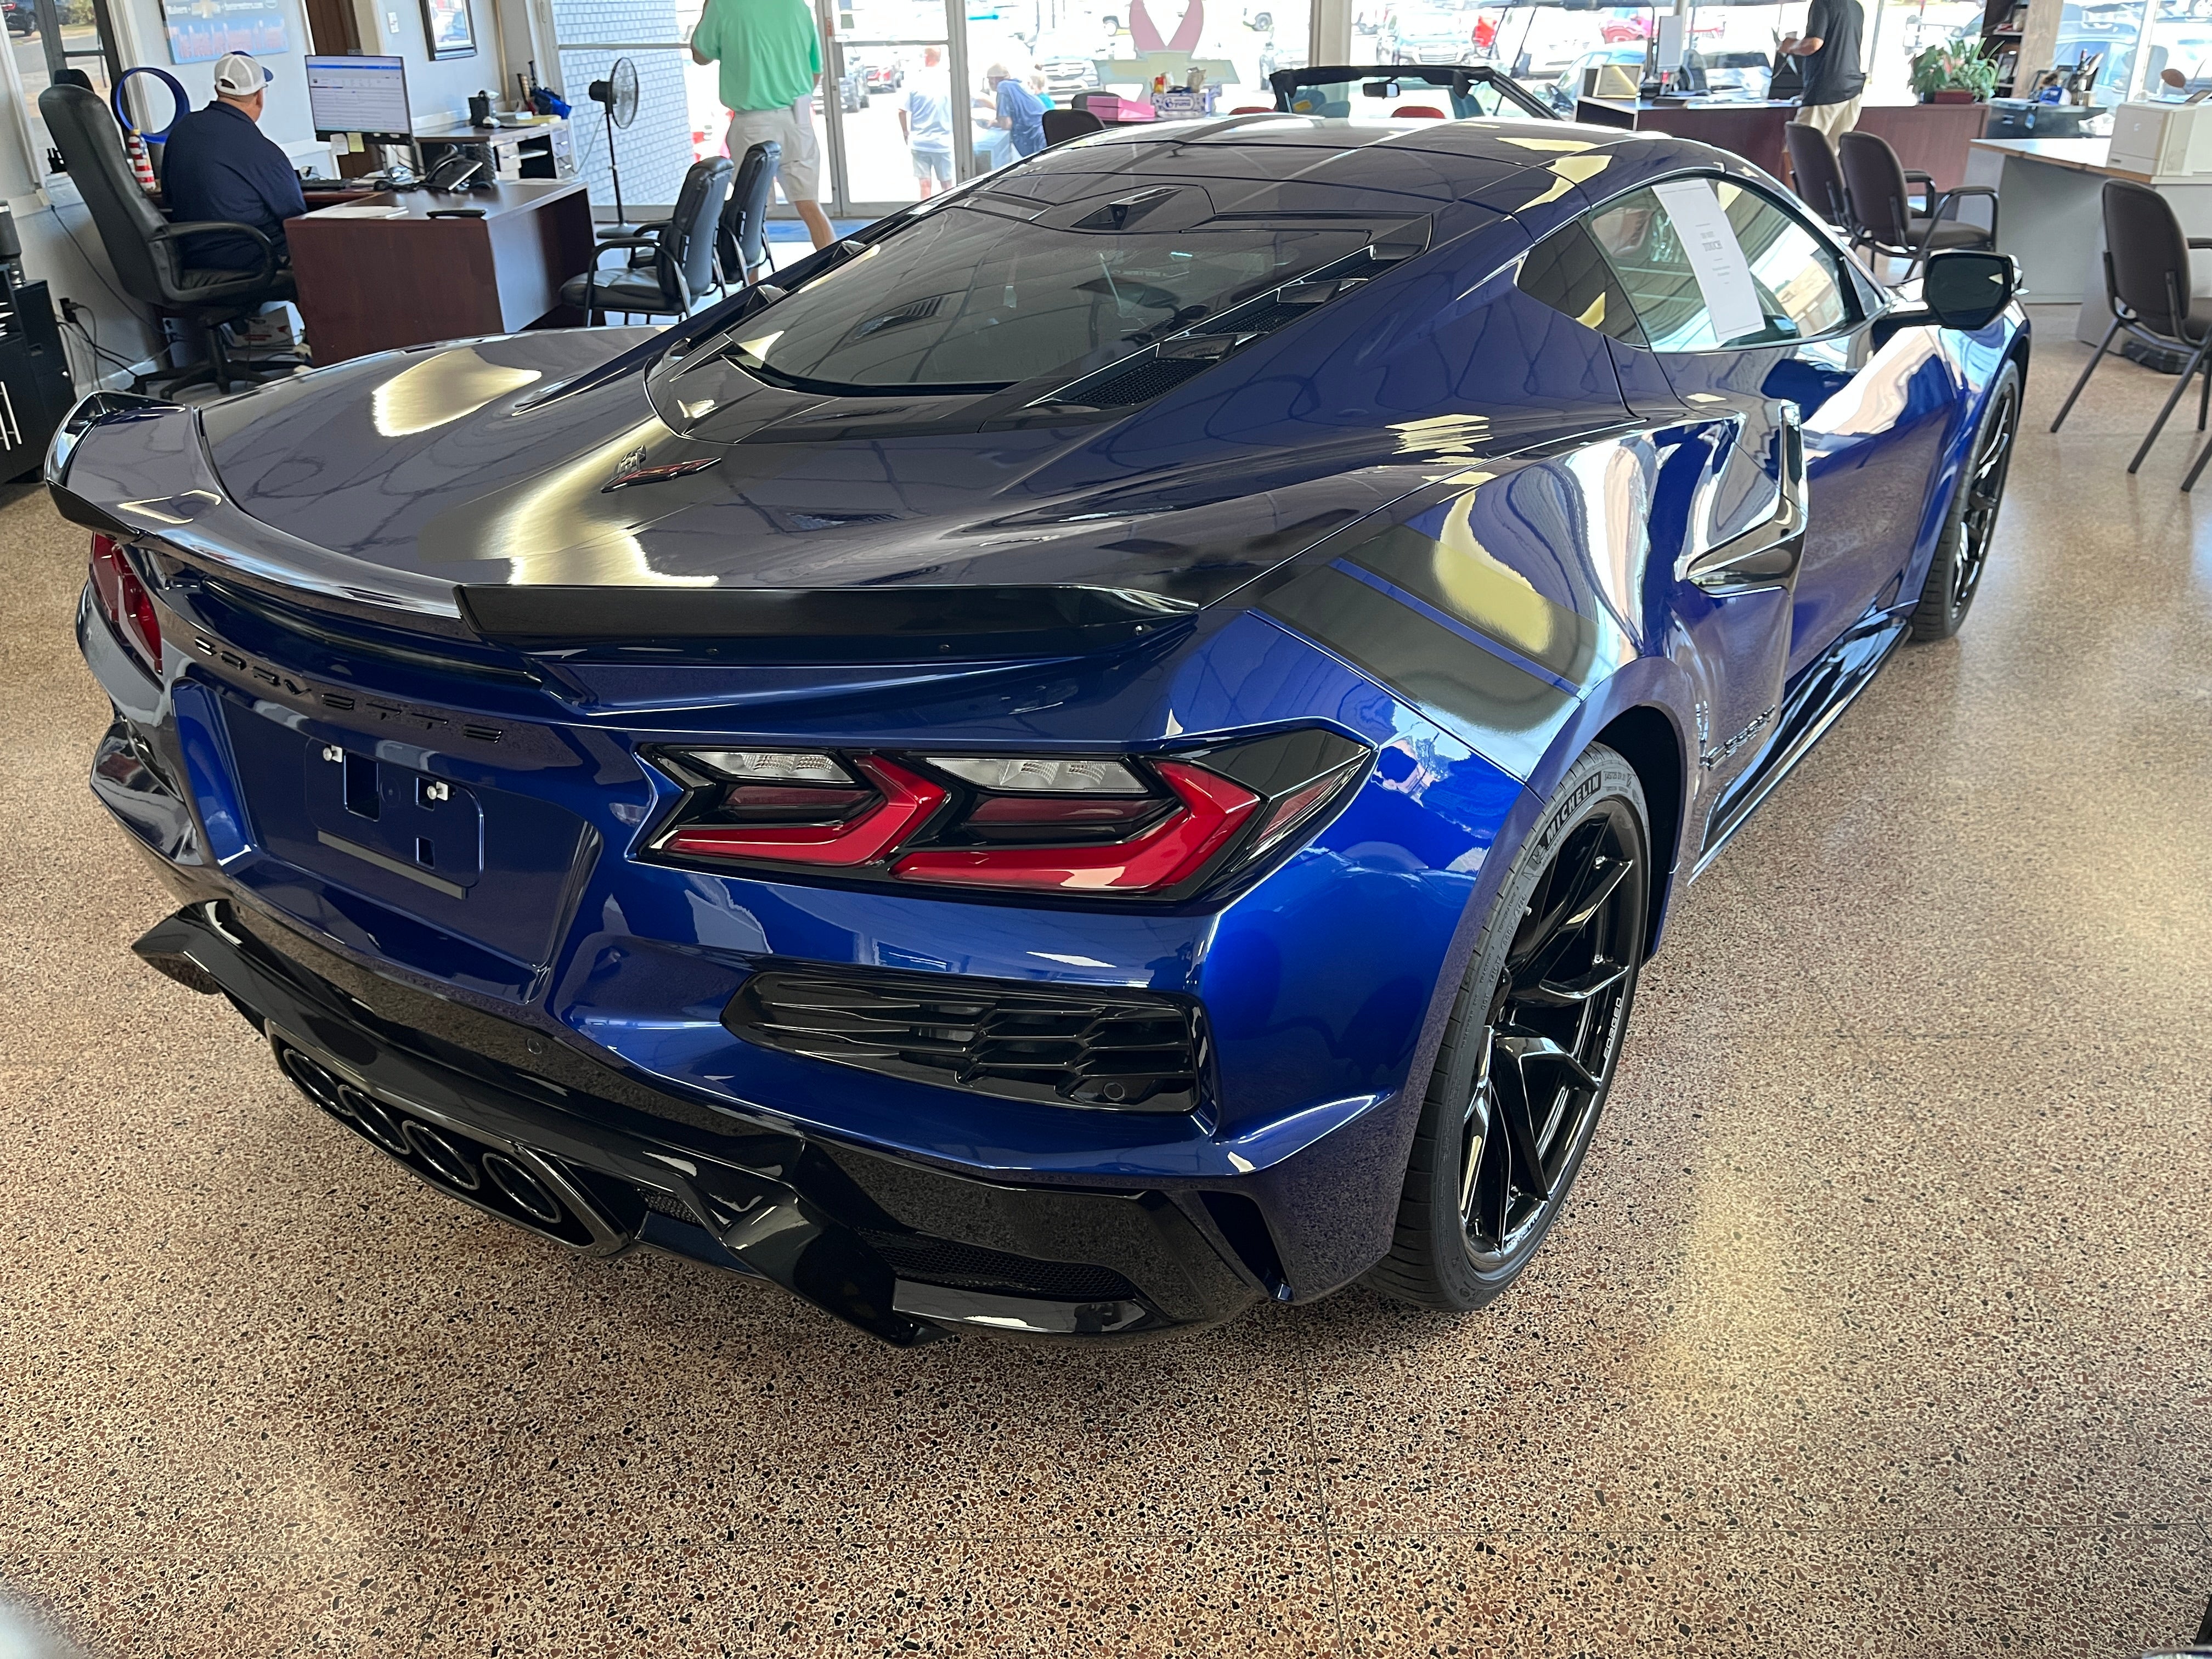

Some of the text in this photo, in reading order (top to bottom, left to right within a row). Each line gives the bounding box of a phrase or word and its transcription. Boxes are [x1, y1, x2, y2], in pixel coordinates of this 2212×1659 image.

[194, 636, 503, 744] CORVETTE
[1546, 774, 1599, 844] MICHELIN
[1480, 952, 1492, 983] TRACTION
[1603, 997, 1622, 1059] FORGED
